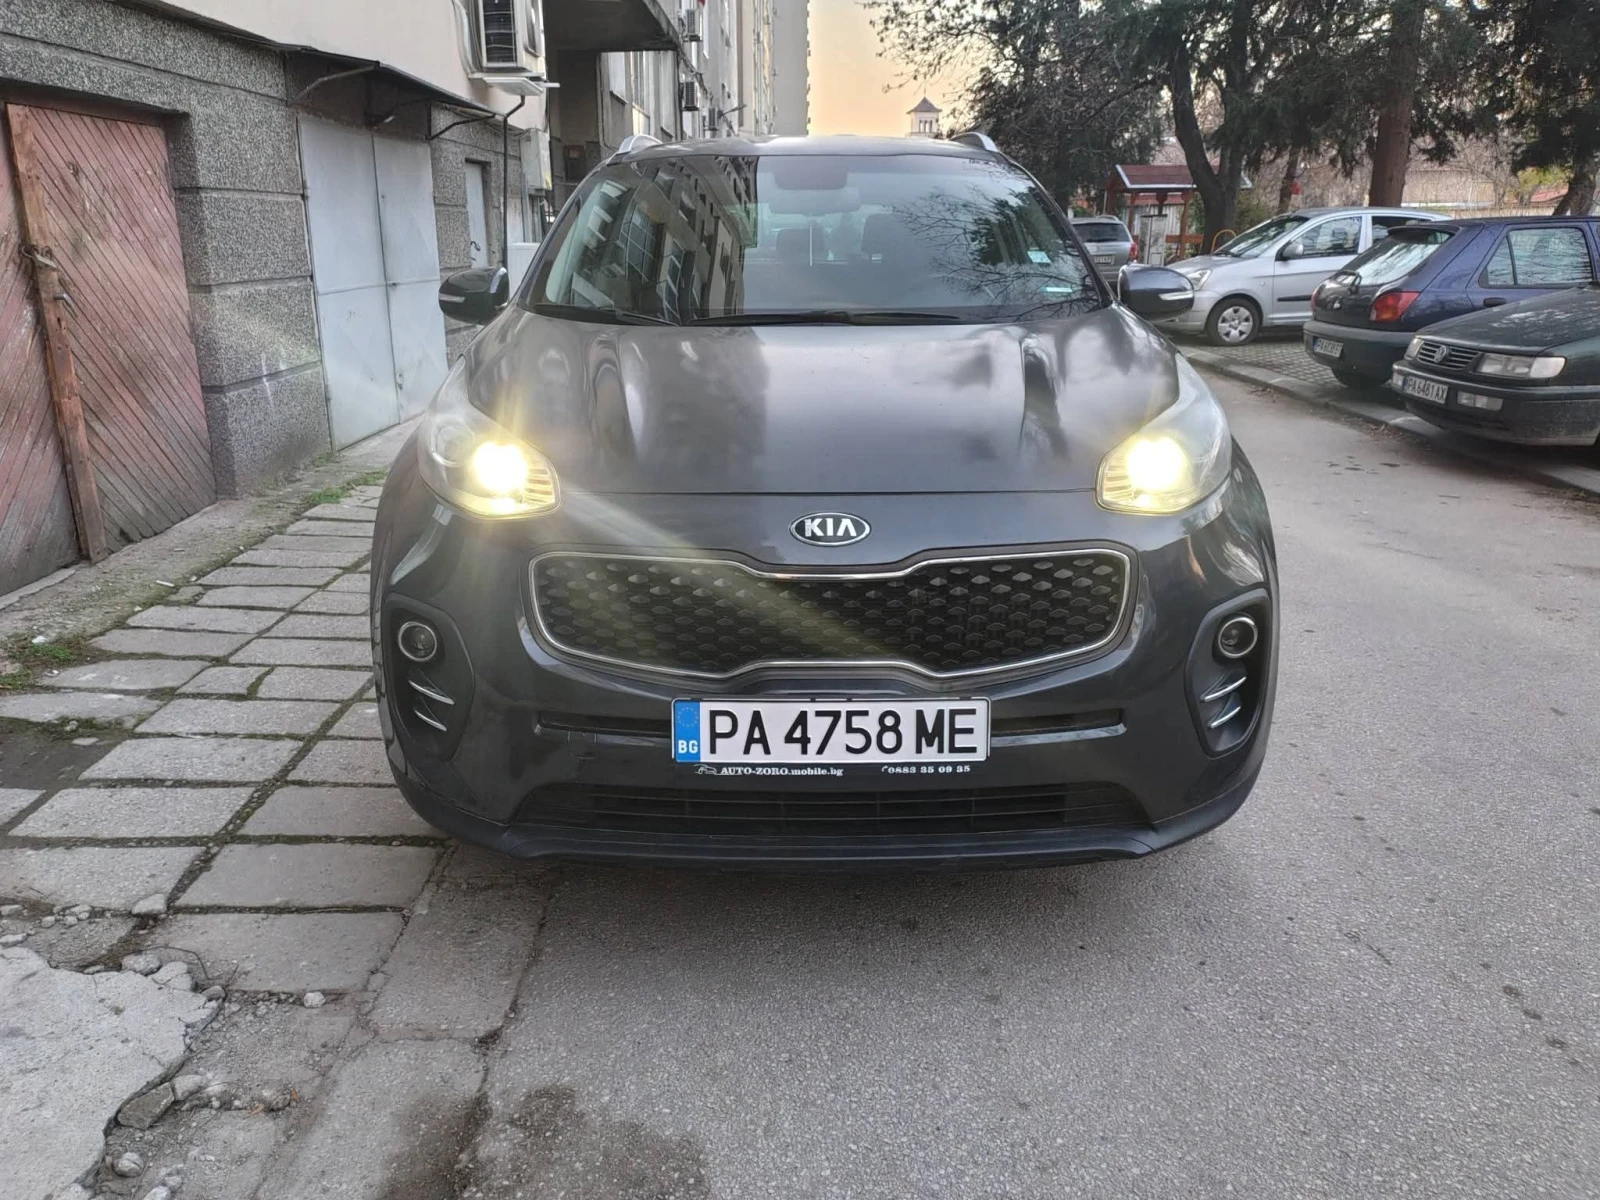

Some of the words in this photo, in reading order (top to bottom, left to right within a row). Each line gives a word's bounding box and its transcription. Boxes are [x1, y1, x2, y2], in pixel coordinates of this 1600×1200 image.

[804, 518, 857, 537] KIA
[678, 740, 698, 754] BG
[720, 766, 844, 776] AUTO-ZORO.mobile.bg
[938, 765, 953, 774] 09
